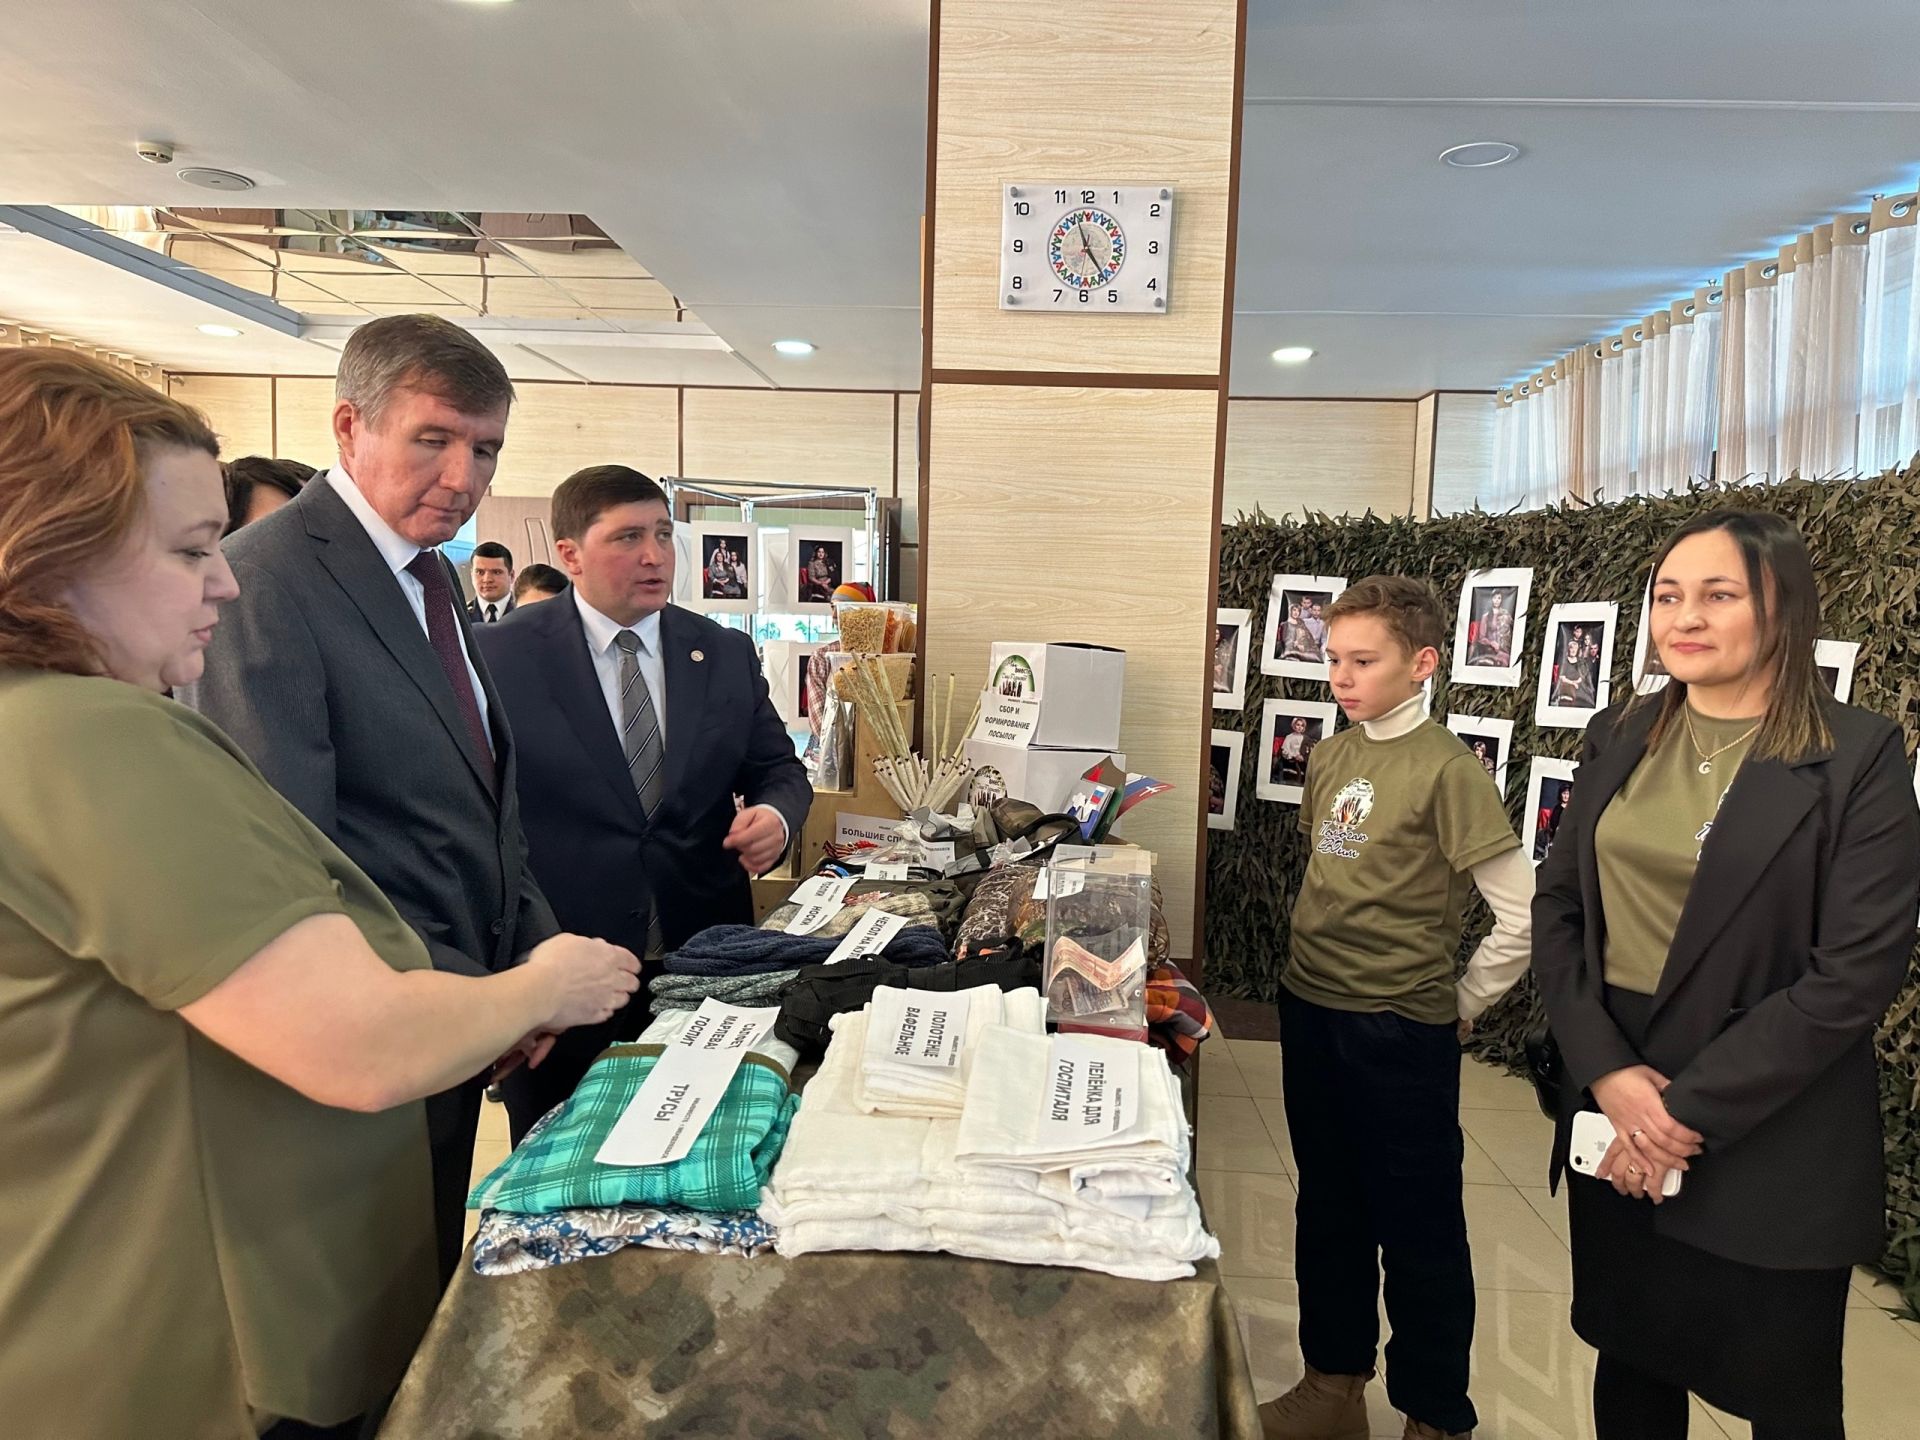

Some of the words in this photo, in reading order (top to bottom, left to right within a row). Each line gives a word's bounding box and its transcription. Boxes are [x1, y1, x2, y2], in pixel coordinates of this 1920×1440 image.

[1055, 190, 1066, 204] 11
[1080, 190, 1095, 204] 12
[1113, 190, 1119, 204] 1
[1013, 202, 1030, 216] 10
[1150, 204, 1160, 217] 2
[1013, 240, 1023, 253] 9
[1148, 241, 1159, 254] 3
[1012, 276, 1022, 289] 8
[1146, 278, 1157, 291] 4
[1053, 289, 1062, 303] 7
[1079, 290, 1089, 303] 6
[1107, 290, 1118, 303] 5
[999, 705, 1014, 715] СБОР
[1015, 707, 1020, 715] И
[984, 716, 1031, 730] ФОРМИРОВАНИЕ
[988, 730, 1017, 741] ПОСЫЛОК
[842, 827, 885, 841] БОЛЬШИЕ
[800, 905, 822, 926] НОСКИ
[867, 916, 890, 936] ЧЕХОЛ
[859, 935, 874, 945] НА
[894, 1006, 921, 1056] ВАФЕЛЬНОЕ
[923, 1010, 947, 1058] ПОЛОТЕНЦЕ
[1086, 1061, 1107, 1104] ПЕЛЁНКА
[1051, 1058, 1075, 1122] ГОСПИТАЛЯ
[653, 1083, 690, 1122] ТРУСЫ
[1083, 1105, 1102, 1126] ДЛЯ
